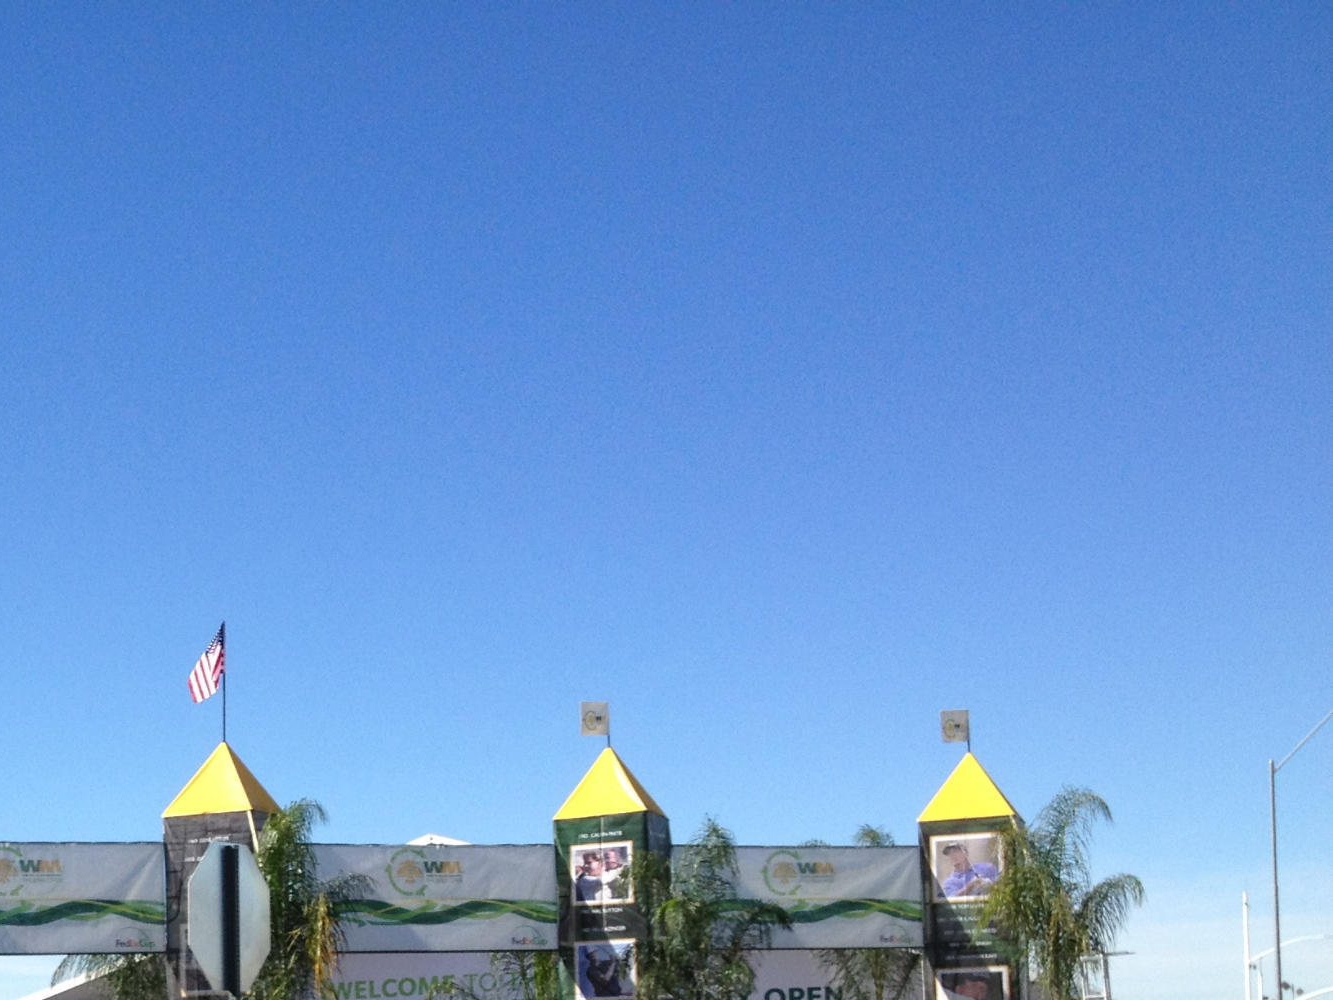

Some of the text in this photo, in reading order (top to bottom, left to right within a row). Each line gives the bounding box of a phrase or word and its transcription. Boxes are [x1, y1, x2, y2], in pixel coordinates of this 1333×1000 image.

[19, 860, 62, 872] WM
[424, 861, 462, 873] WM
[798, 862, 835, 874] WM
[330, 974, 455, 1000] WELCOME
[465, 972, 496, 993] TO
